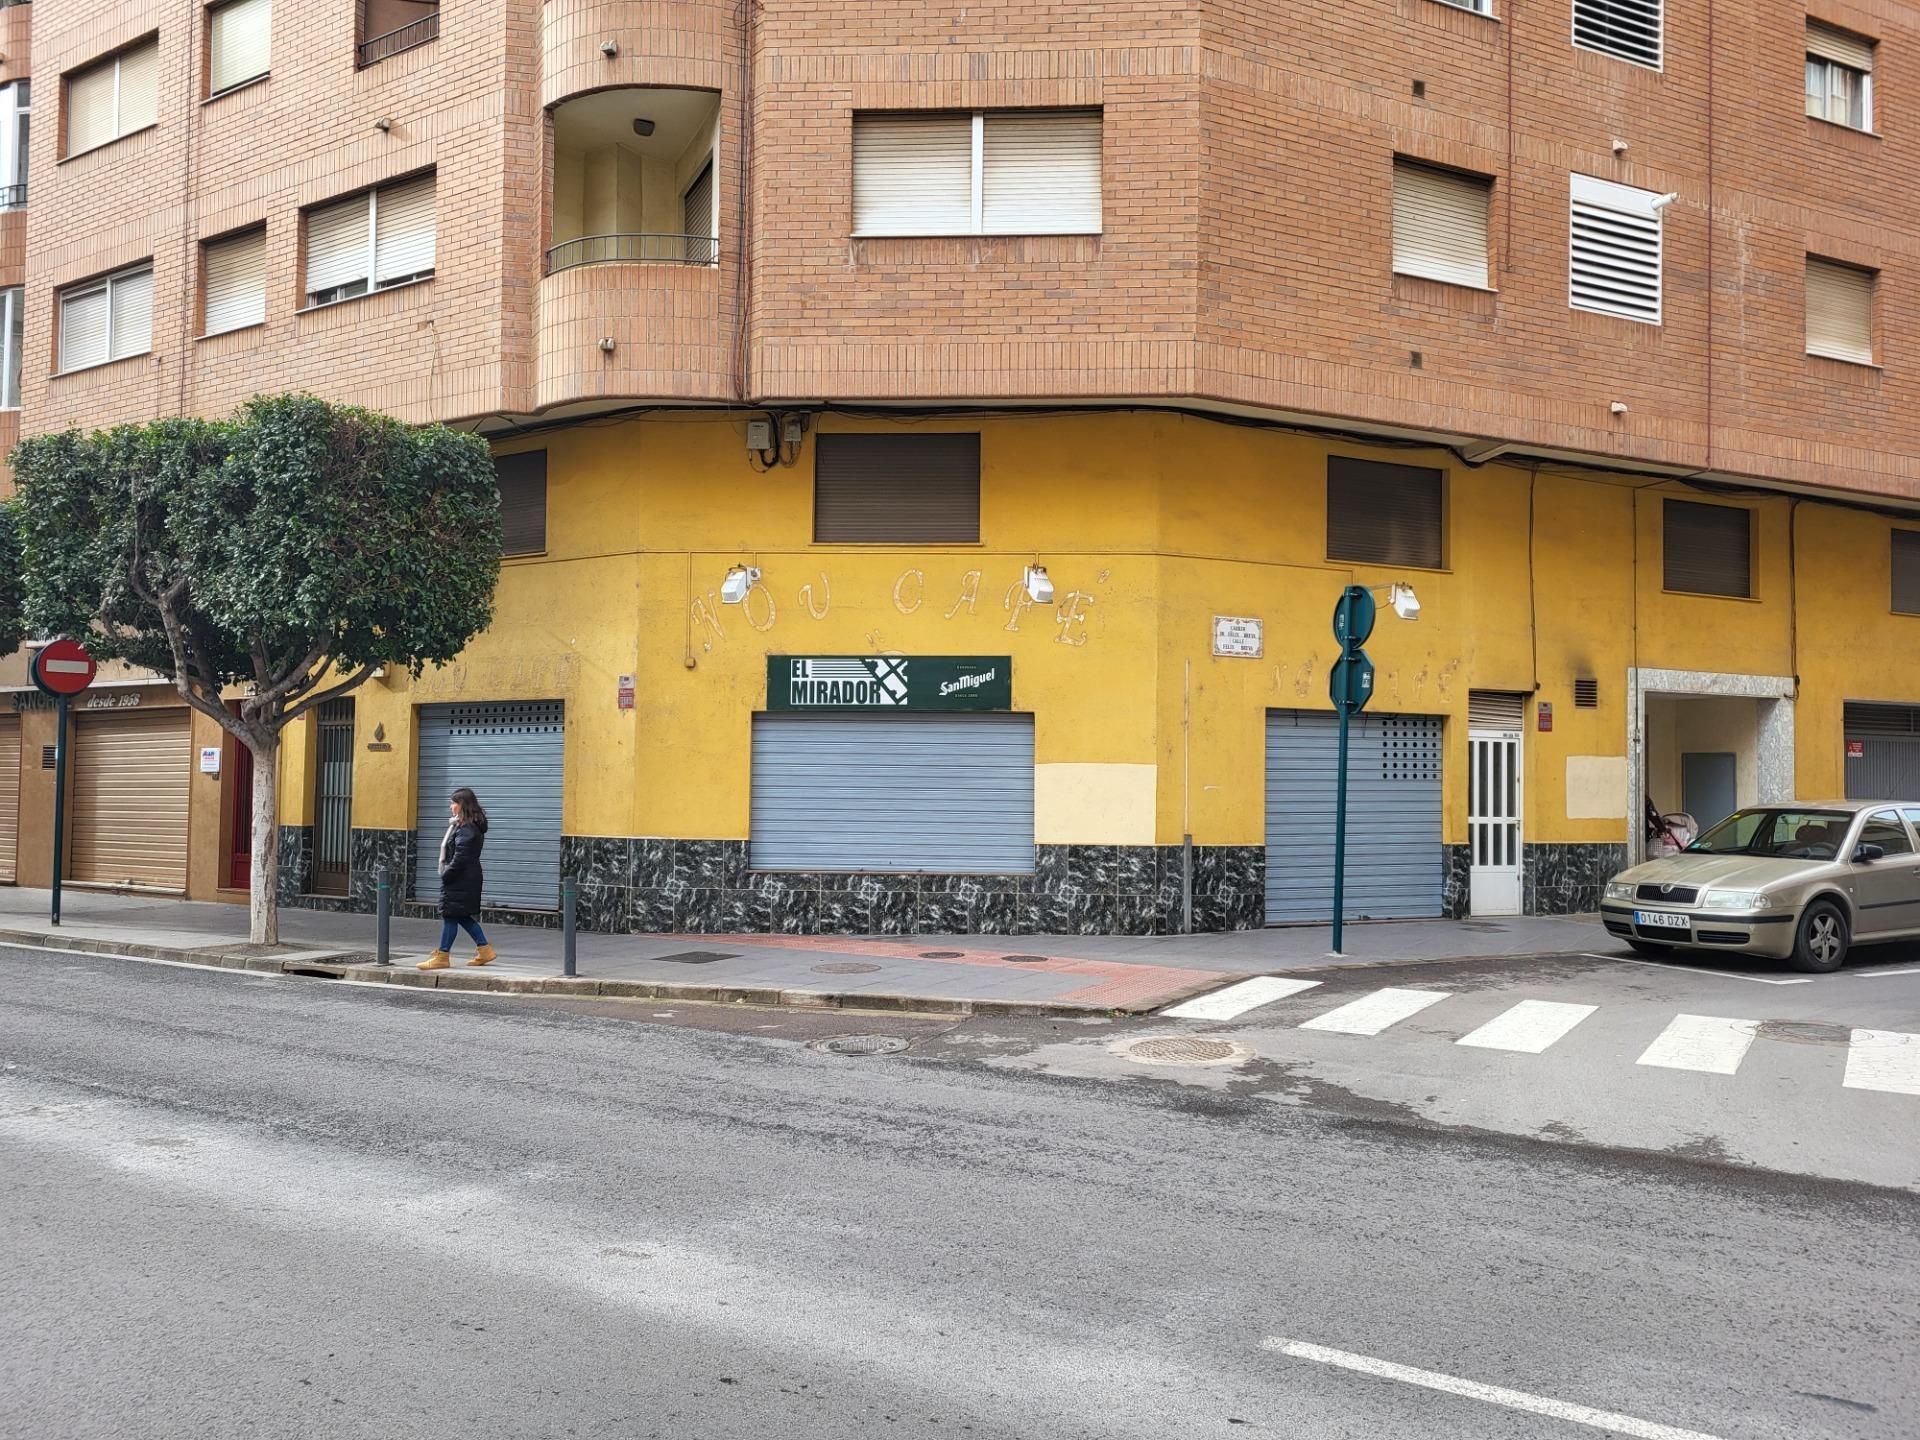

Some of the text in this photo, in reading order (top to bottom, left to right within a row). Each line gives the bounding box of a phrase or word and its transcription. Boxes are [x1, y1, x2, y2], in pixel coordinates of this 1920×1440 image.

[690, 571, 833, 652] NOU
[792, 660, 809, 678] EL
[87, 693, 117, 708] desde
[792, 680, 881, 704] MIRADOR
[1641, 912, 1687, 927] 0146 DZX
